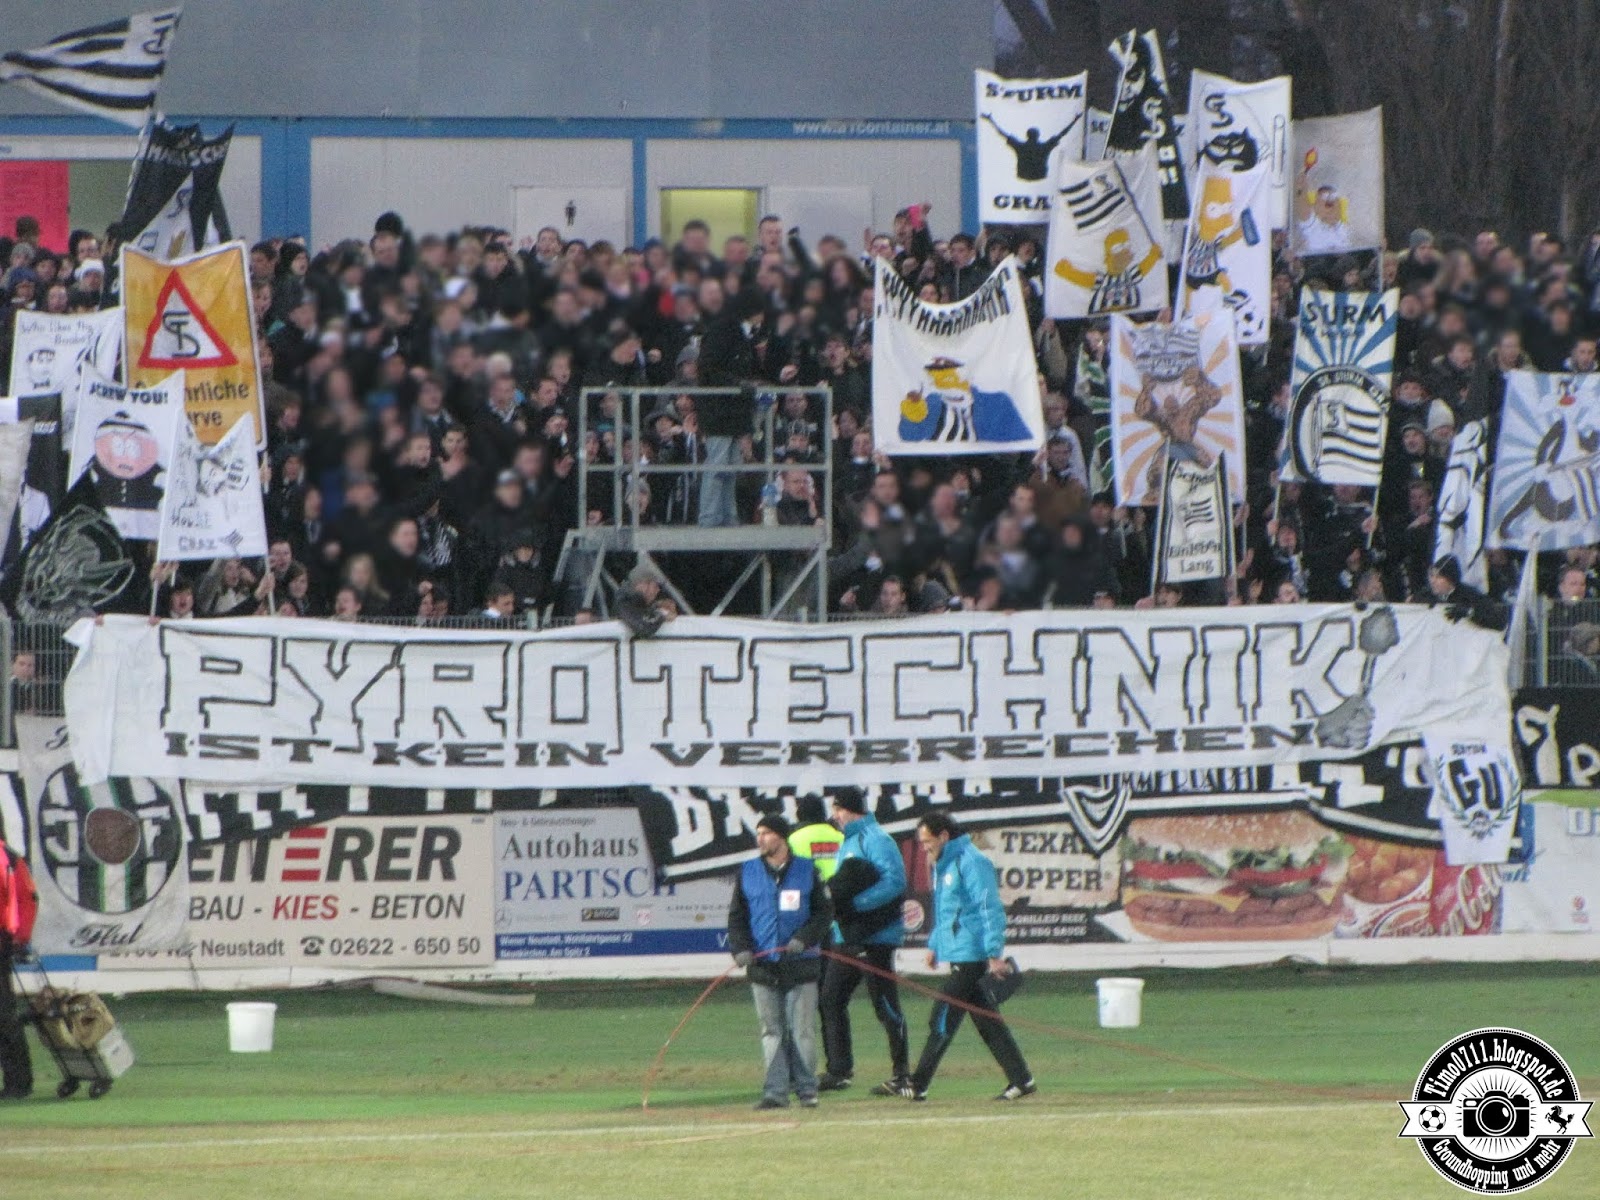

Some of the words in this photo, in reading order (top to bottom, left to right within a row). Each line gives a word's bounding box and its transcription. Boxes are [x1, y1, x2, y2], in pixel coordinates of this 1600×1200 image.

[993, 194, 1051, 211] GRA
[130, 390, 169, 404] YOU!
[184, 379, 250, 400] hrliche
[187, 410, 222, 426] rve
[160, 616, 1356, 748] PYROTECHNIK
[164, 731, 332, 763] IST
[372, 741, 608, 767] KEIN
[651, 721, 1316, 767] VERBRECHEN
[502, 832, 640, 860] Autohaus
[1001, 831, 1080, 854] TEXA
[272, 894, 340, 921] KIES
[370, 894, 466, 920] BETON
[201, 938, 285, 956] Neustadt
[329, 937, 394, 956] 02622
[414, 936, 450, 955] 650
[458, 936, 481, 955] 50
